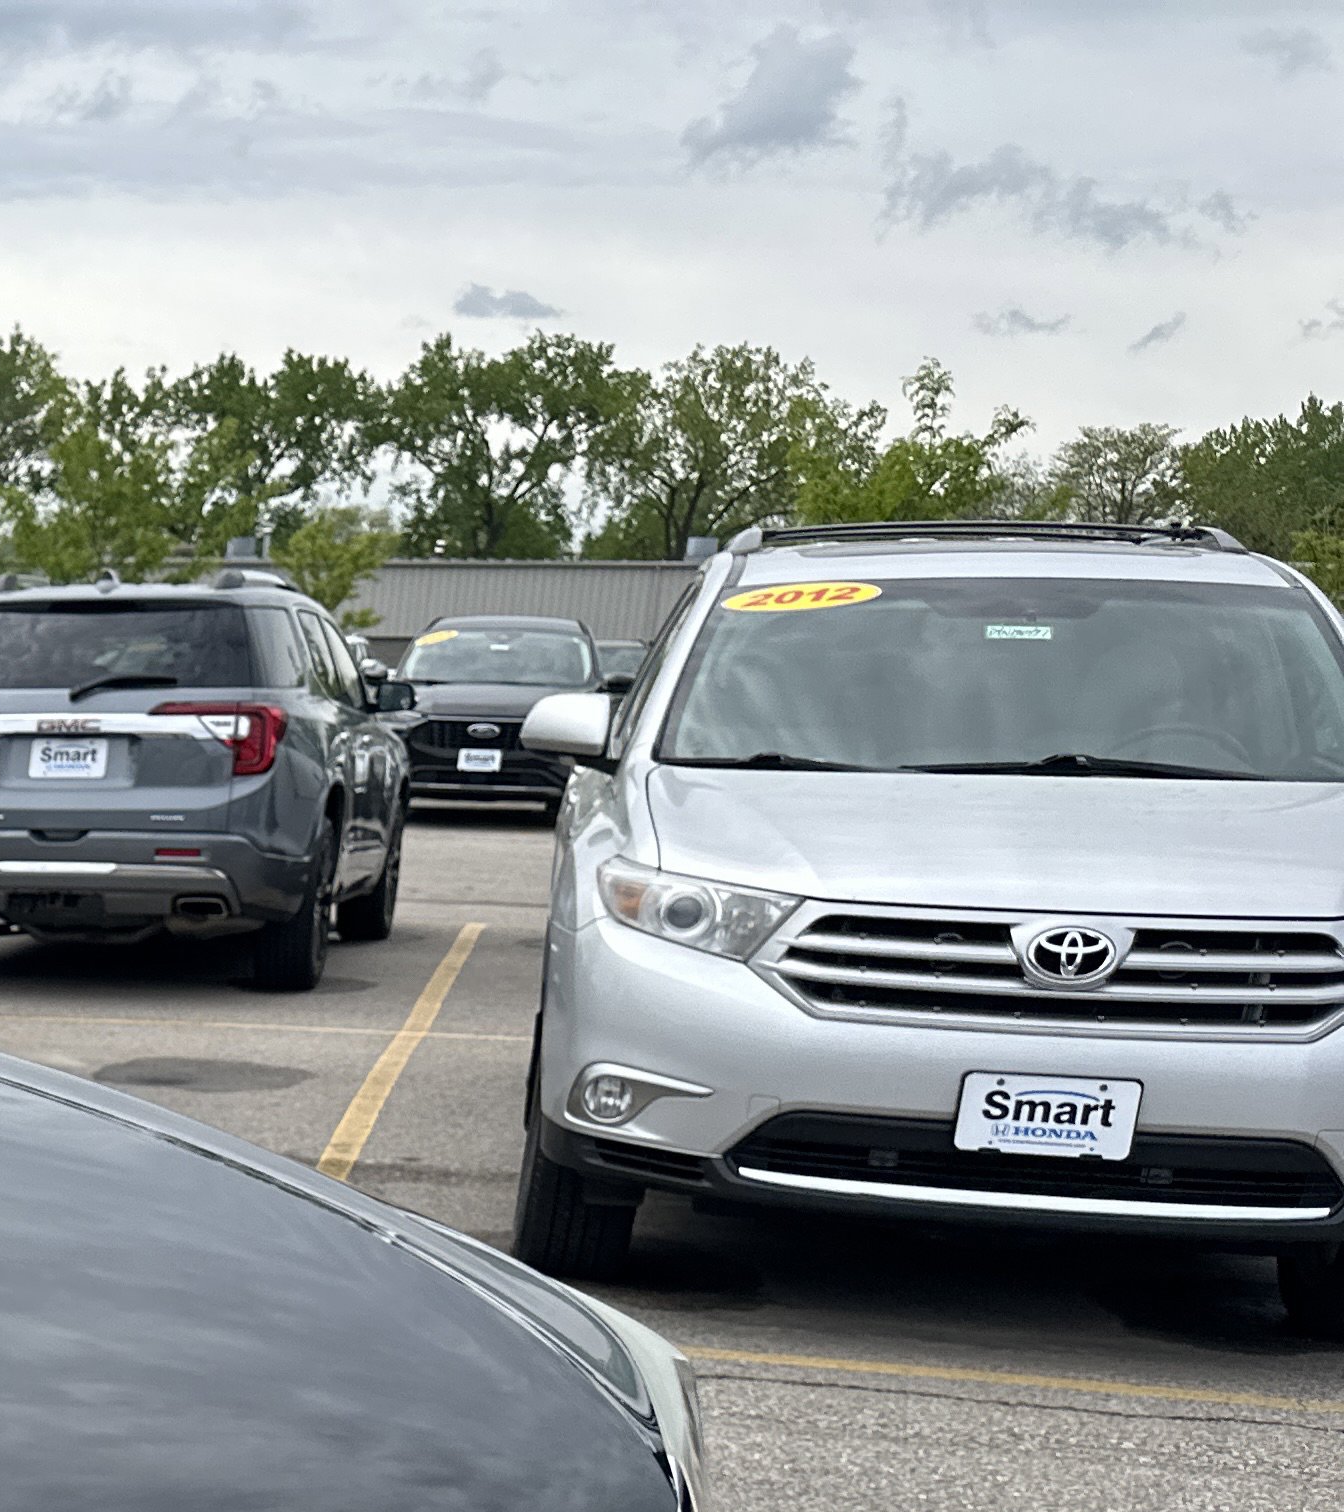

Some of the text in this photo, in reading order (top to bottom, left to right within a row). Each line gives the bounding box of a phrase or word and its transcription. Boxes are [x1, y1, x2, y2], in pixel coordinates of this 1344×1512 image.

[741, 586, 862, 607] 2012
[37, 719, 101, 732] GMC
[40, 746, 97, 763] Smart
[982, 1090, 1116, 1127] Smart
[1013, 1126, 1097, 1141] HONDA
